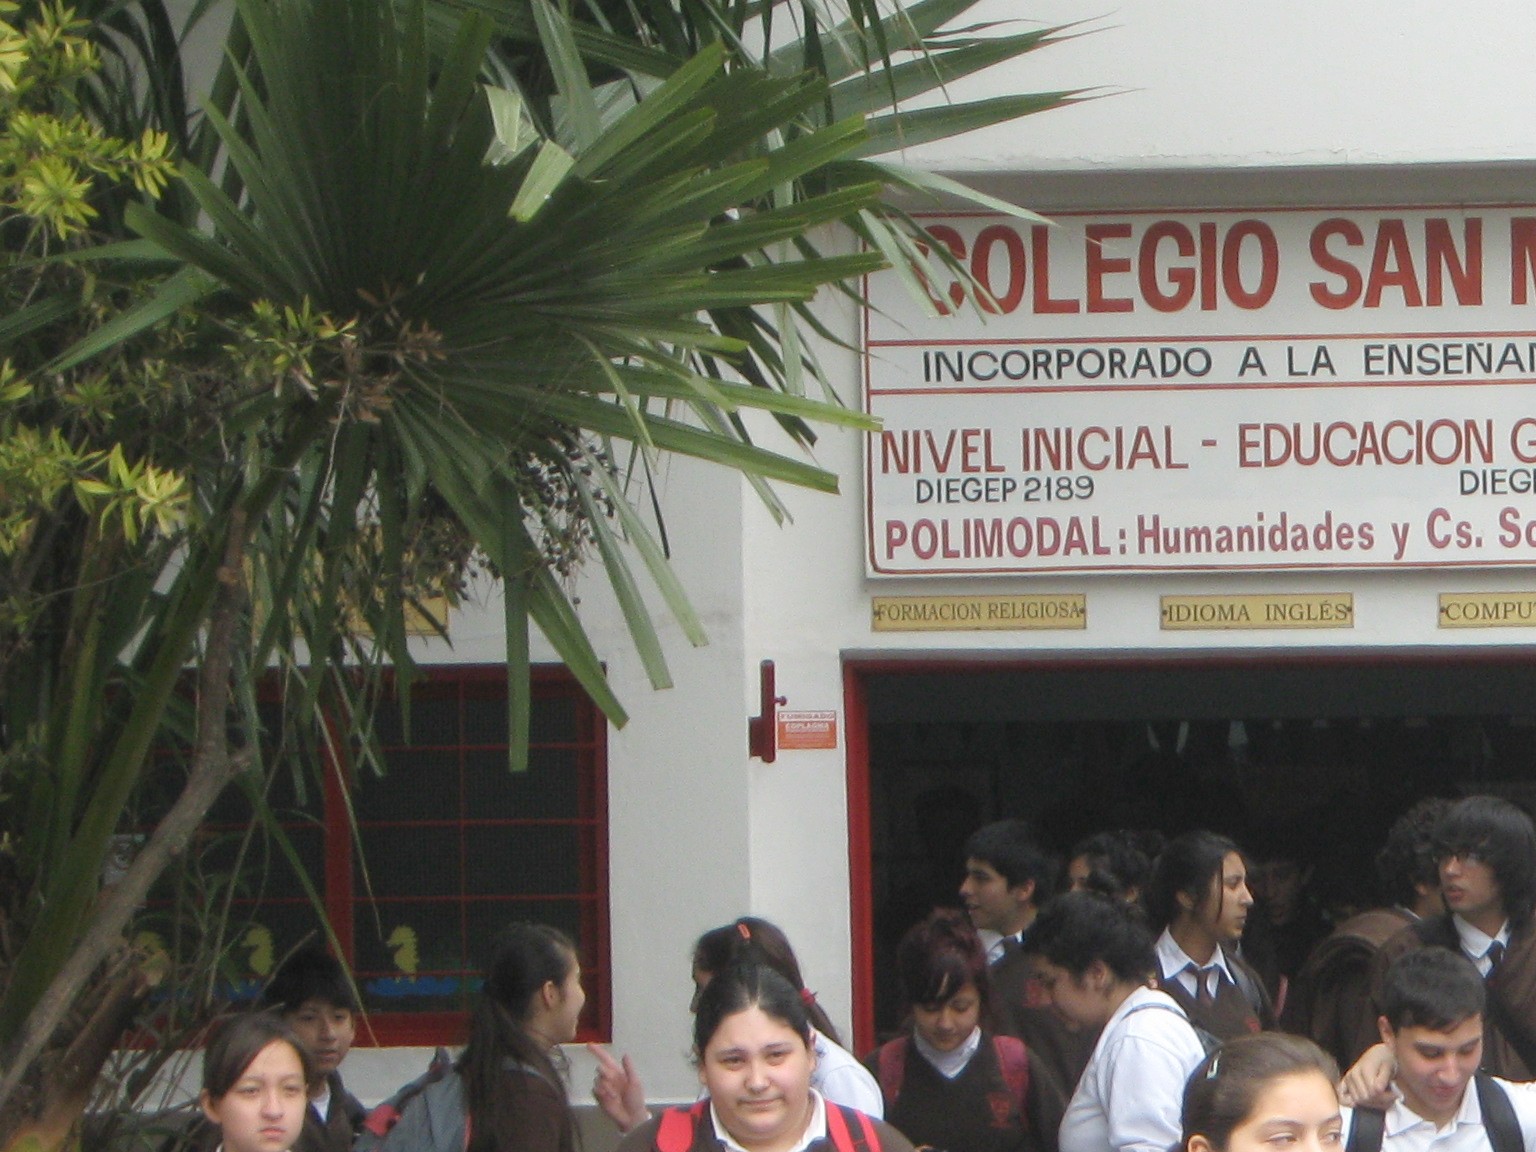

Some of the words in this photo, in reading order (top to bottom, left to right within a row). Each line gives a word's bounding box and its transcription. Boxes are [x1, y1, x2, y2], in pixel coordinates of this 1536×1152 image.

[909, 218, 1280, 315] COLEGIO
[1308, 216, 1484, 310] SAN
[923, 346, 1213, 383] INCORPORADO
[1238, 345, 1267, 377] A
[1286, 345, 1336, 376] LA
[881, 428, 1007, 474] NIVEL
[1021, 424, 1190, 472] INICIAL
[1237, 419, 1494, 468] EDUCACION
[915, 477, 1018, 505] DIEGEP
[1023, 475, 1095, 502] 2189
[1136, 510, 1375, 556] Humanidades
[1391, 521, 1411, 560] y
[1425, 506, 1484, 550] Cs.
[877, 603, 982, 622] FORMACION
[987, 601, 1081, 620] RELIGIOSA
[1167, 603, 1251, 622] IDIOMA
[1264, 600, 1348, 622] INGLÉS
